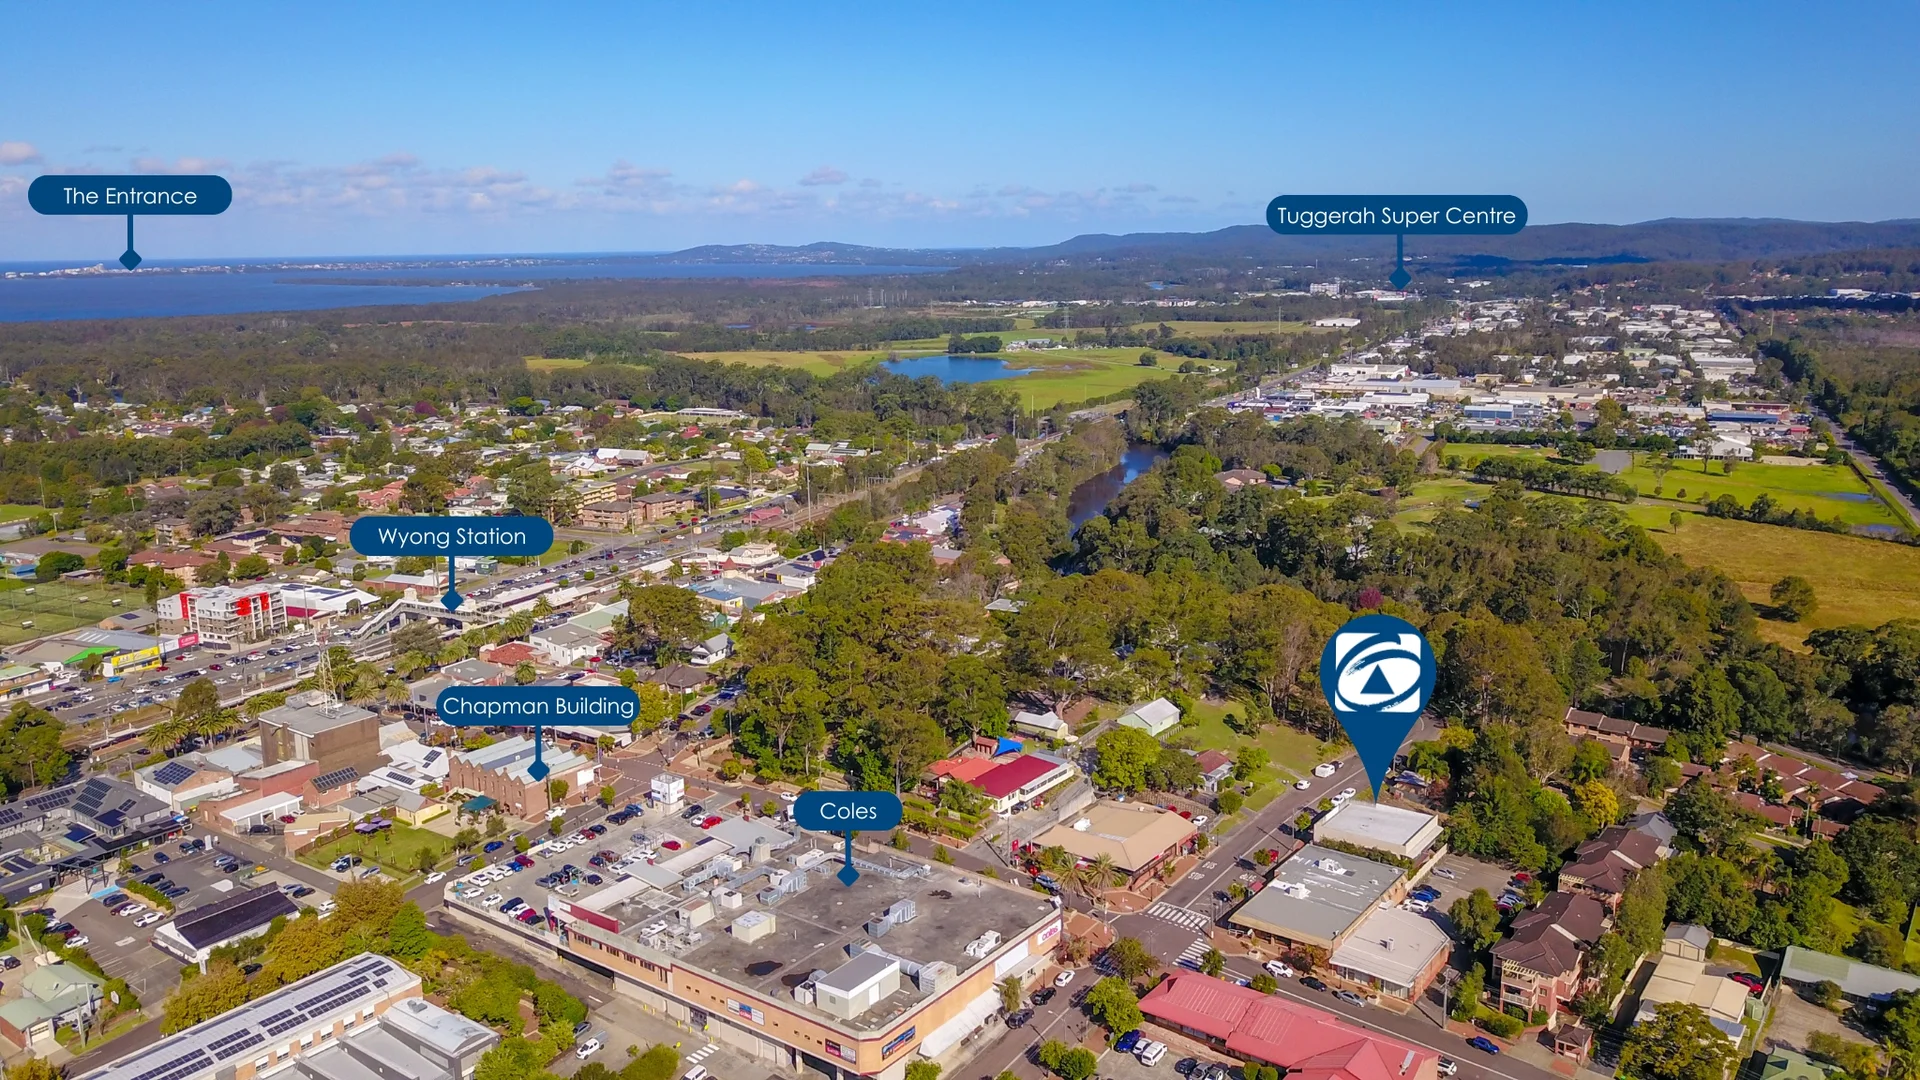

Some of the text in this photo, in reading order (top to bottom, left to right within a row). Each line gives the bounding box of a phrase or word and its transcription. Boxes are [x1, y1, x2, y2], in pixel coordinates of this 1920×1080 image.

[1201, 861, 1218, 870] BUS
[1187, 871, 1206, 881] STOP
[1041, 926, 1059, 941] coles
